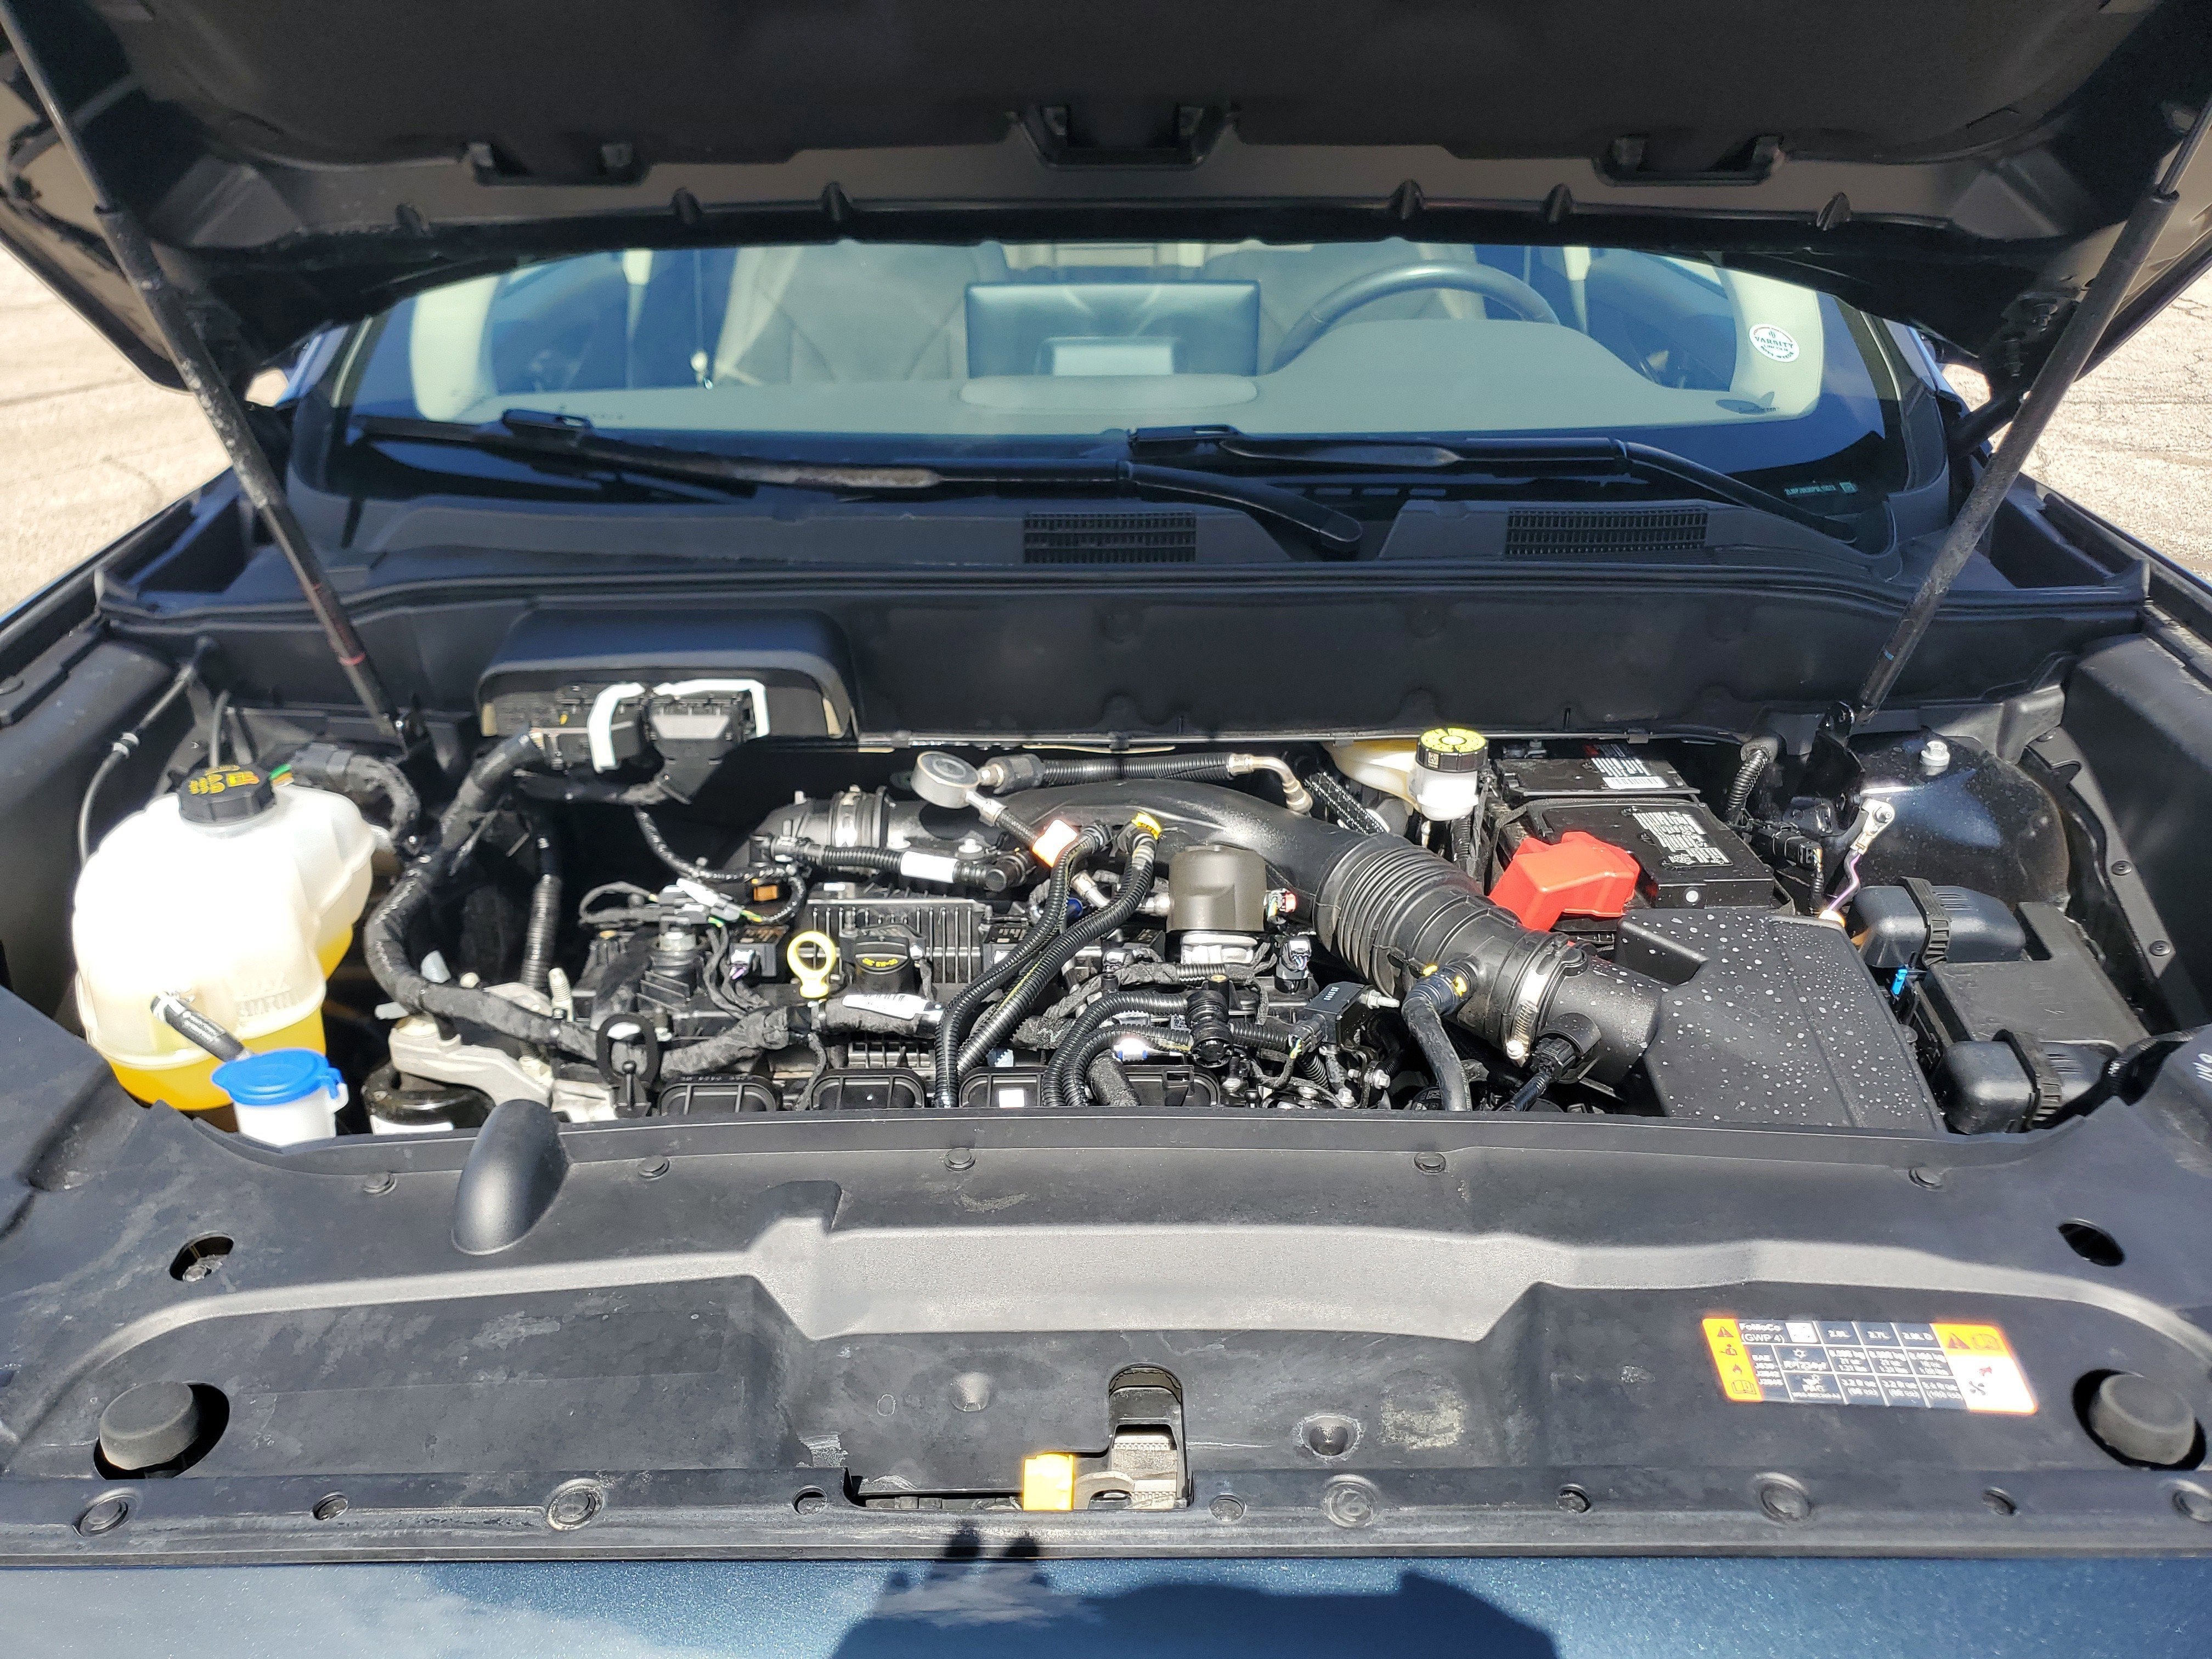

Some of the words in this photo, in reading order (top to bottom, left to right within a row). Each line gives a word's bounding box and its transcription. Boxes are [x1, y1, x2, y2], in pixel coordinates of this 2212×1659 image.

[1754, 336, 1793, 349] VARSITY
[1739, 1323, 1782, 1331] FoMoCo
[1741, 1333, 1771, 1342] (GWP
[1774, 1334, 1785, 1343] 4)
